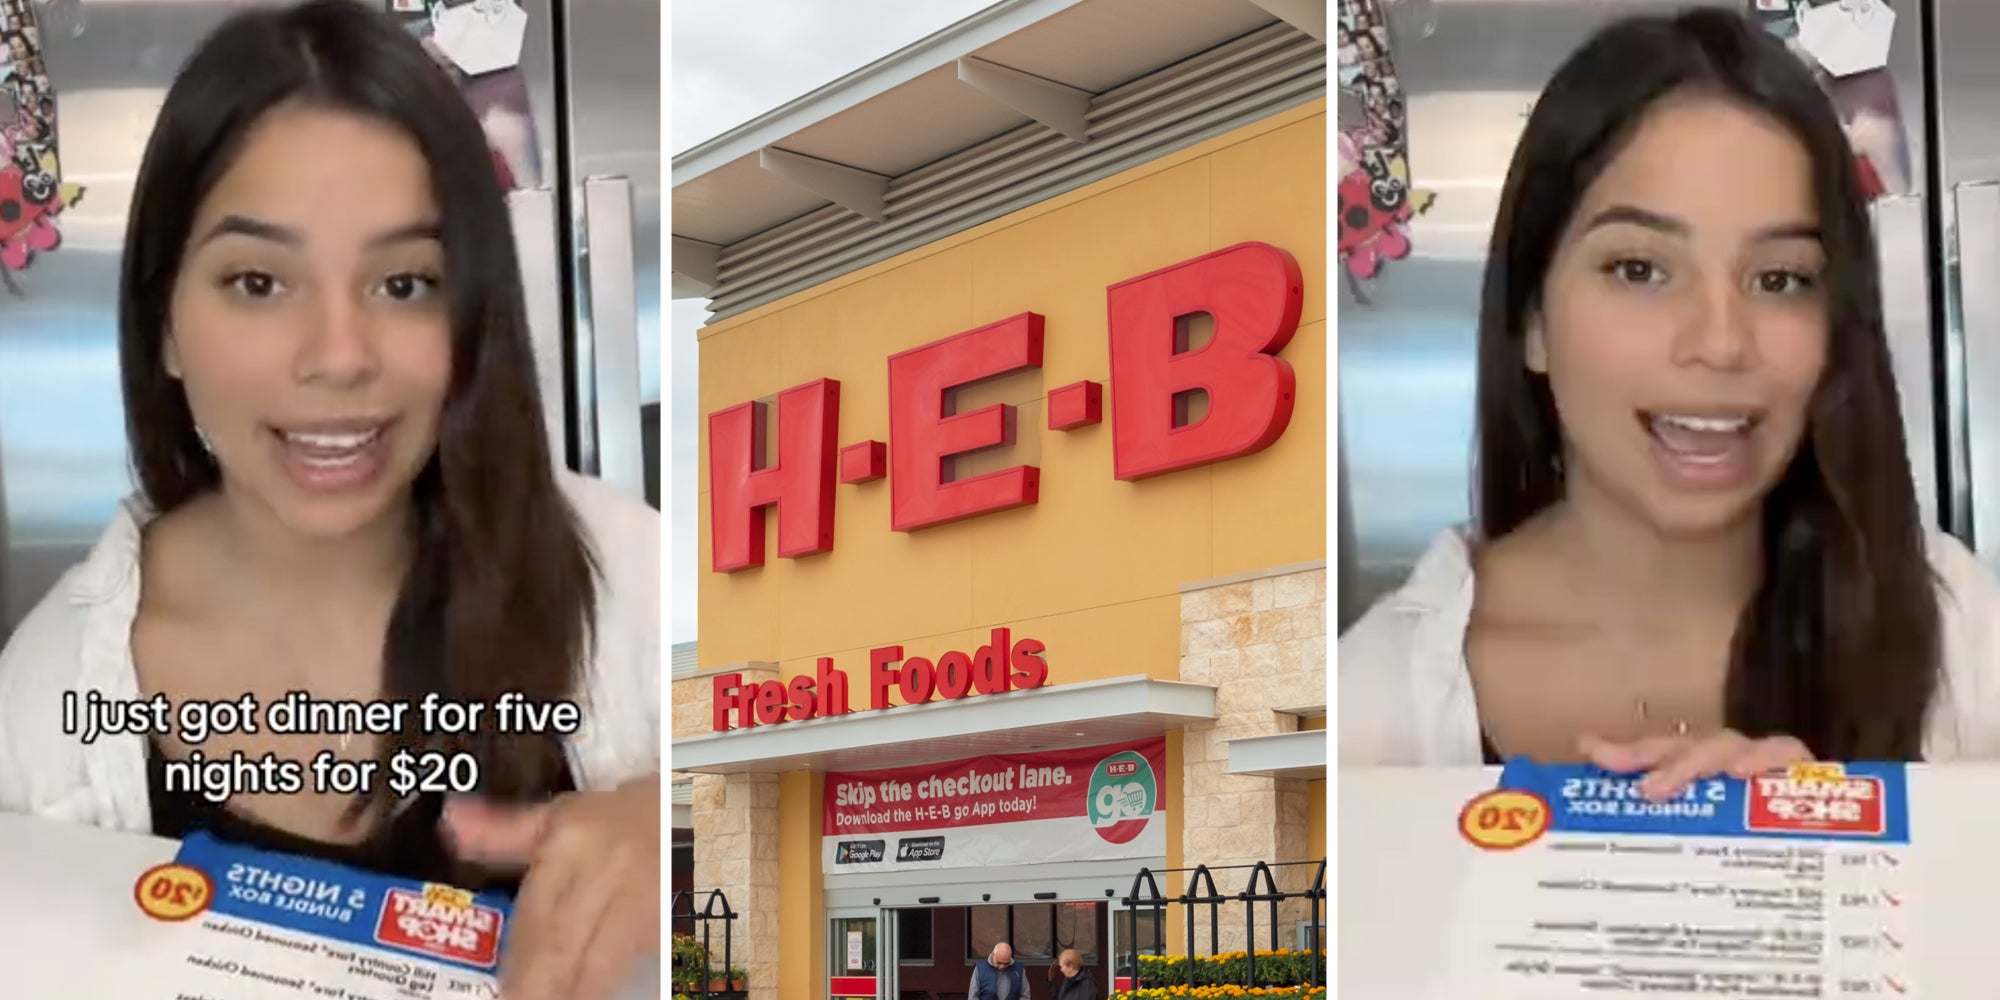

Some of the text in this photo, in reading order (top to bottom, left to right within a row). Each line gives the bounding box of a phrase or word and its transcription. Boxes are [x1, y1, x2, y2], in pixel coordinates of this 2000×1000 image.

[713, 627, 1048, 731] Fresh Foods
[836, 763, 1072, 809] Skip the checkout lane.
[836, 795, 1037, 827] Download the H-E-B go App today!
[849, 849, 882, 861] Google Play
[908, 847, 941, 859] App Store
